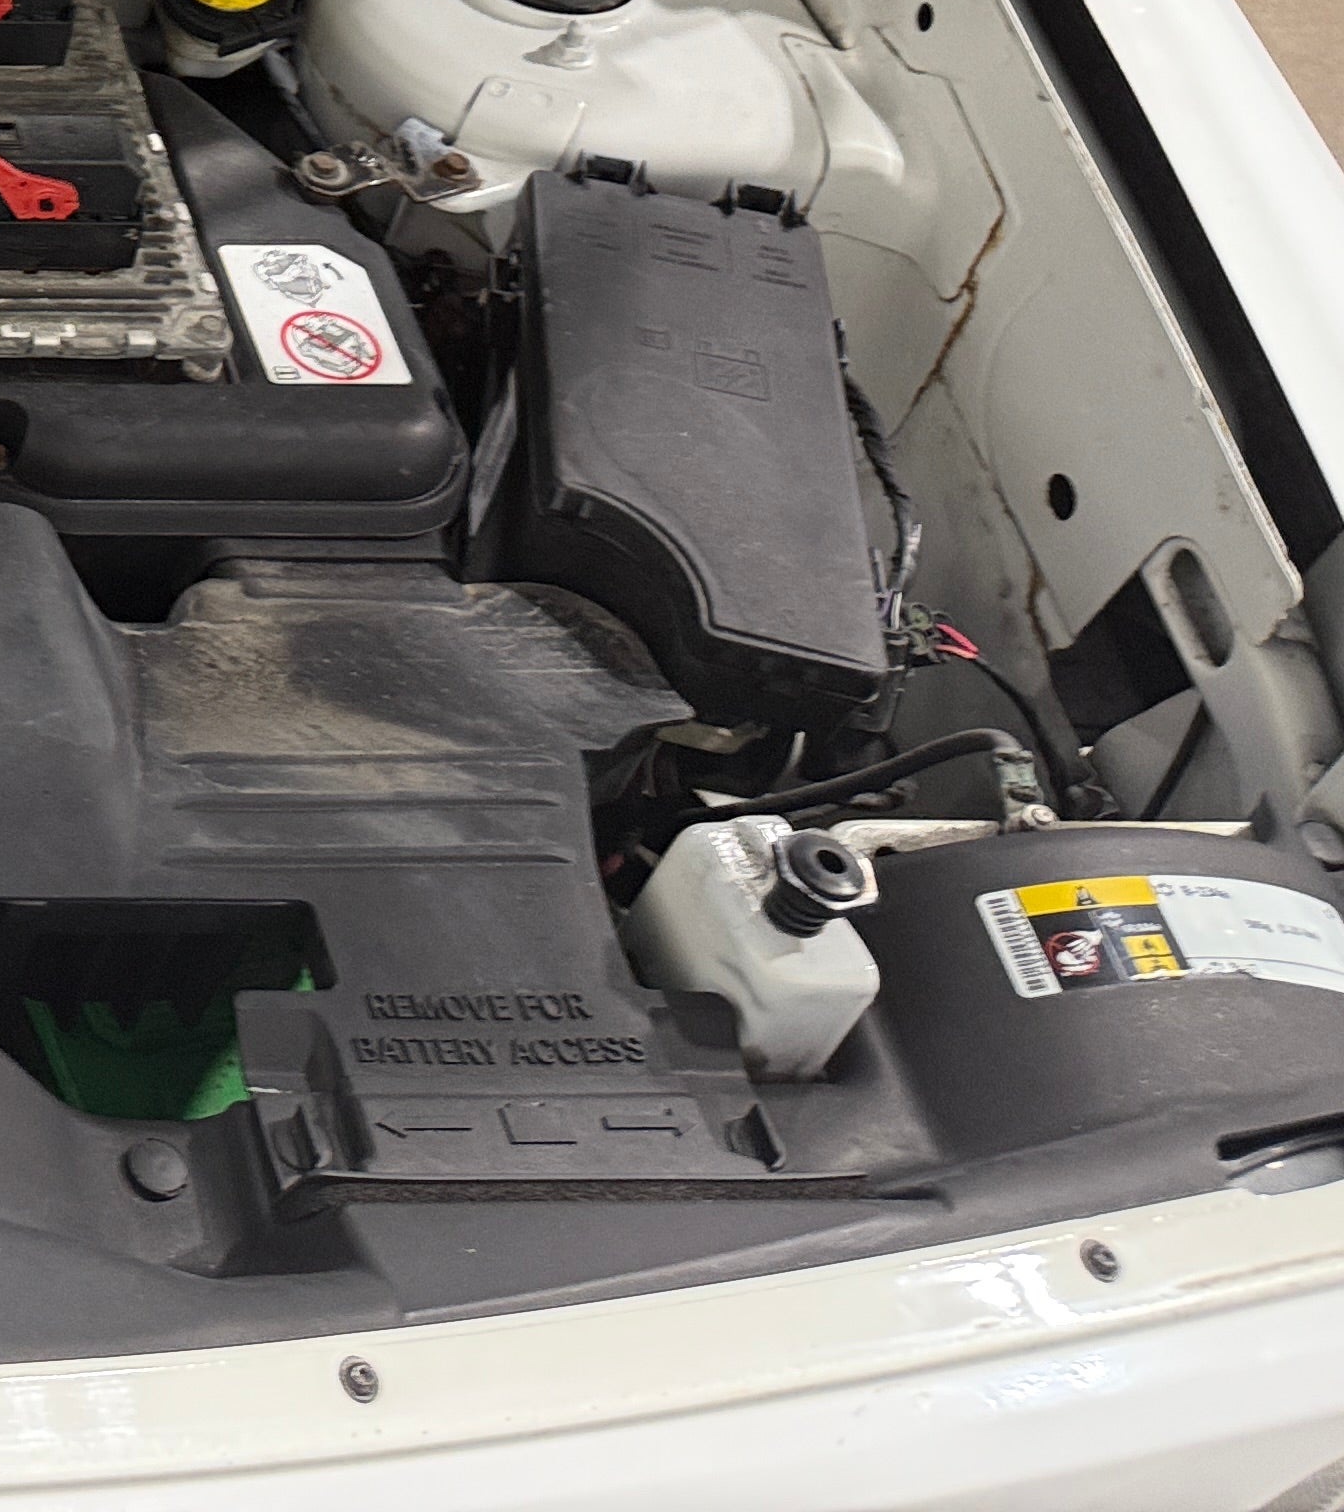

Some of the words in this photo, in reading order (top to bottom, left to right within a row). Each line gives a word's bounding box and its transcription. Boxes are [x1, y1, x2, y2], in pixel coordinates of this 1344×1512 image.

[365, 991, 515, 1022] REMOVE
[514, 990, 593, 1022] FOR
[349, 1036, 497, 1067] BATTERY
[507, 1035, 648, 1067] ACCESS
